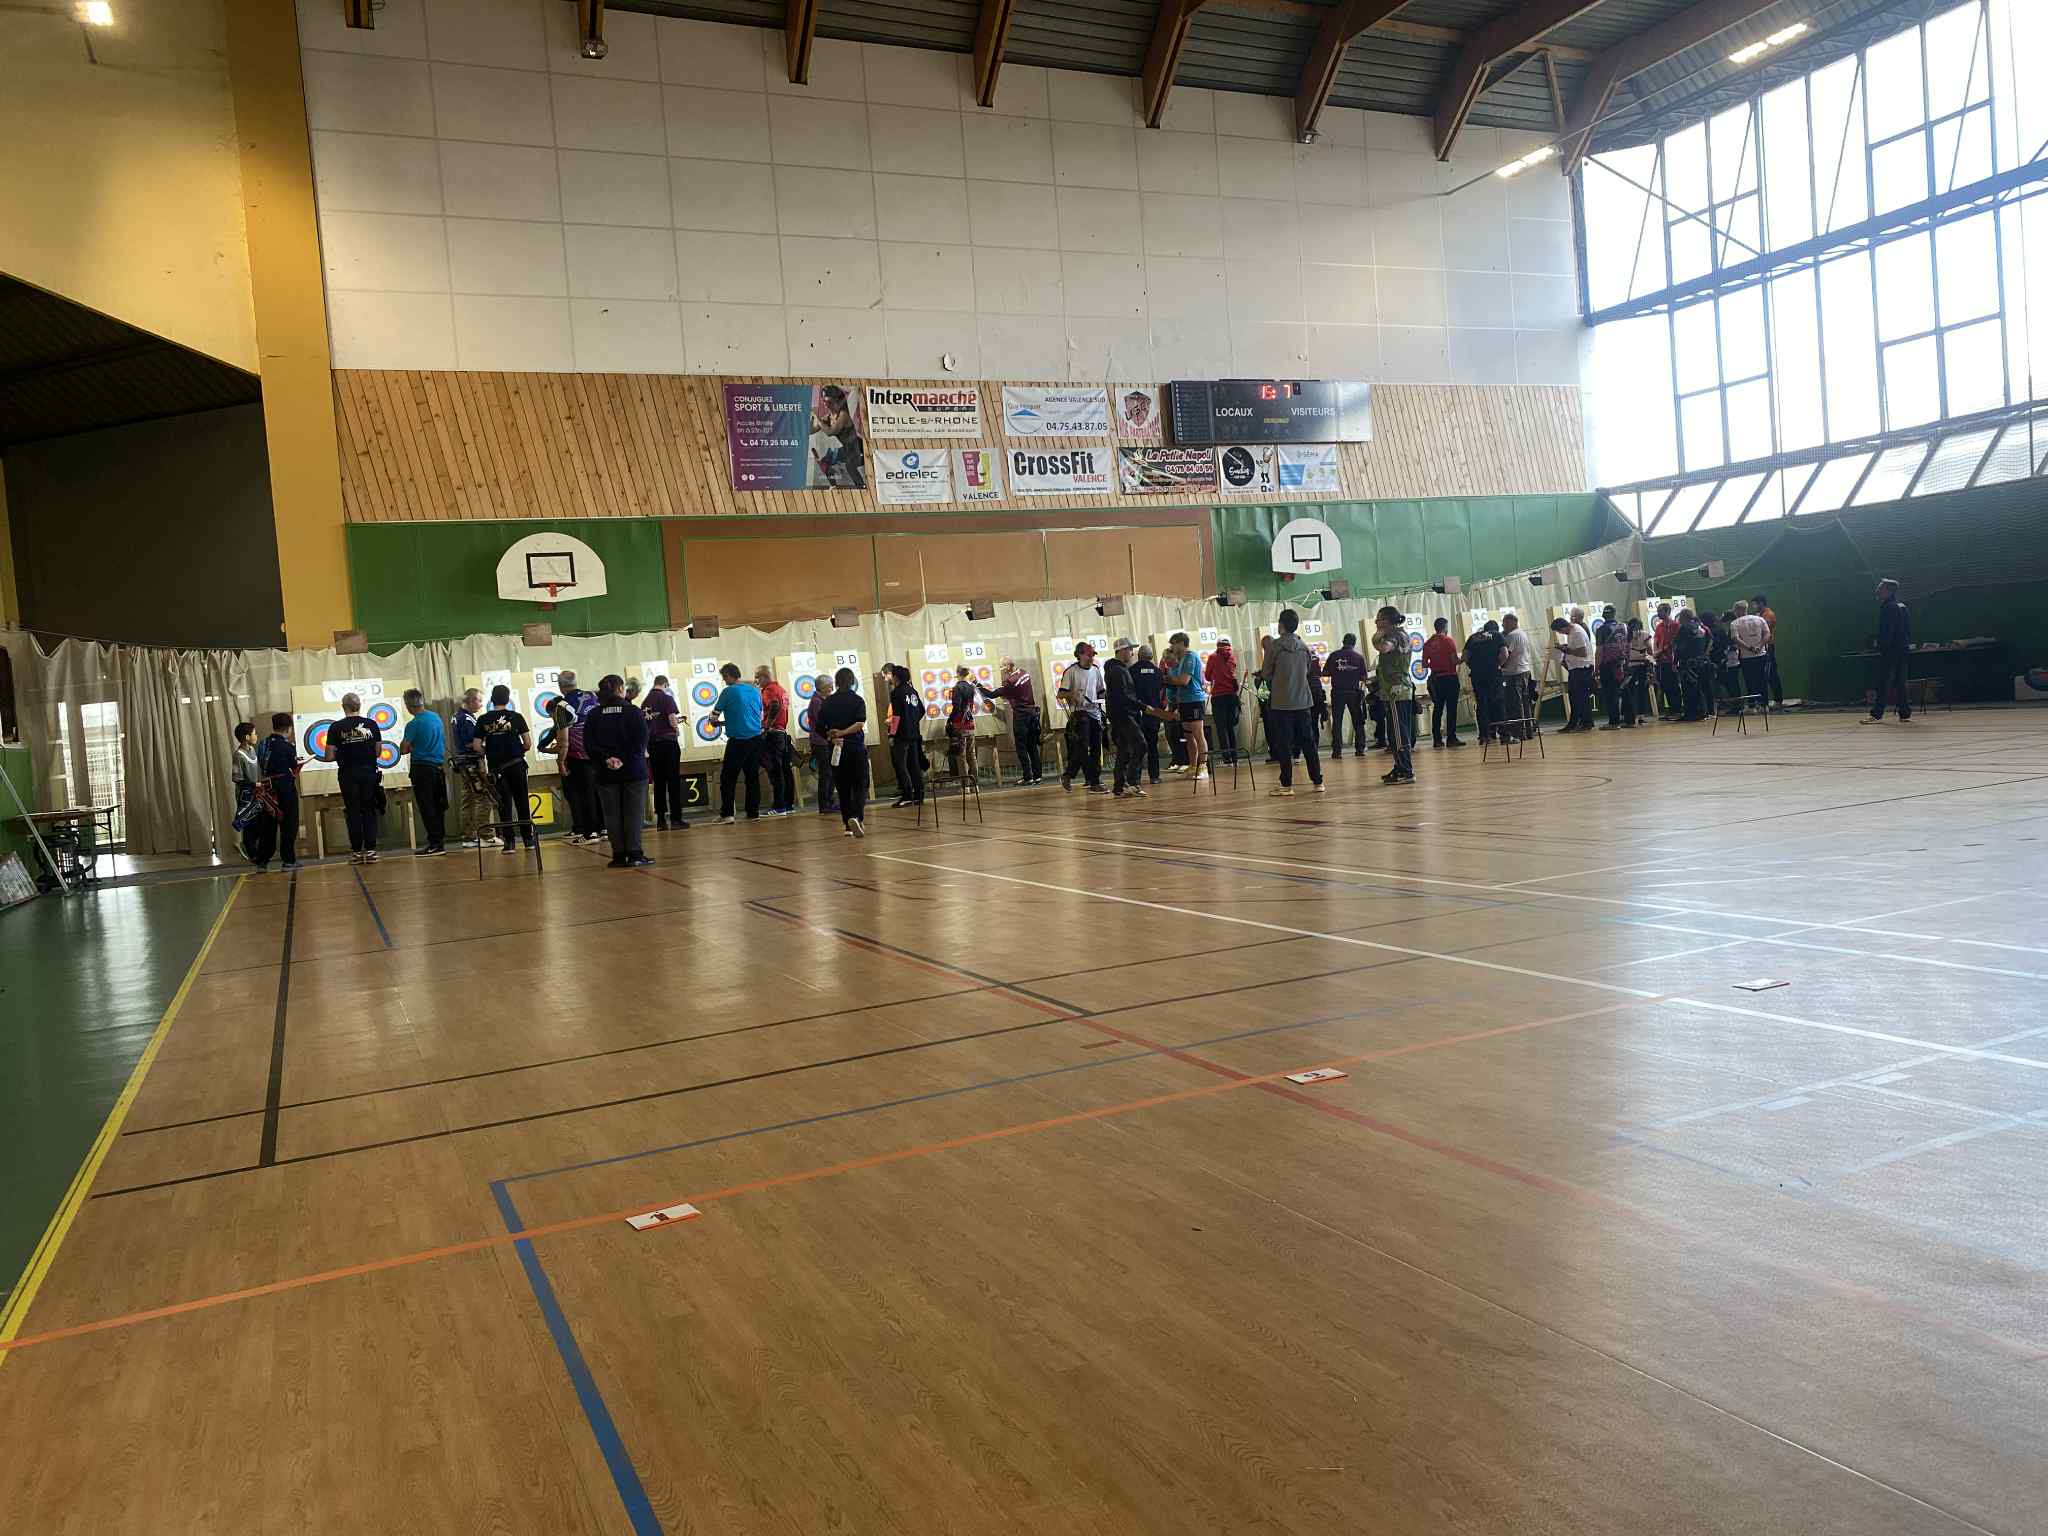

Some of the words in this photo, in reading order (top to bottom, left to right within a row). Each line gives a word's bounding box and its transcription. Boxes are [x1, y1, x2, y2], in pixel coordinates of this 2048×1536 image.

[734, 395, 774, 403] CONJUGUEZ
[869, 388, 977, 411] Intermarché
[735, 403, 762, 412] SPORT
[772, 401, 803, 412] LIBERTÉ
[1215, 407, 1254, 417] LOCAUX
[1290, 407, 1336, 417] VISITEURS
[1146, 449, 1158, 462] La
[1159, 449, 1184, 462] Petite
[1185, 447, 1213, 463] Napoli
[1013, 451, 1095, 476] CrossFit
[885, 469, 939, 480] edrelec
[1072, 474, 1106, 483] VALENCE
[963, 491, 1000, 501] VALENCE
[685, 777, 700, 803] 3
[528, 793, 544, 819] 2
